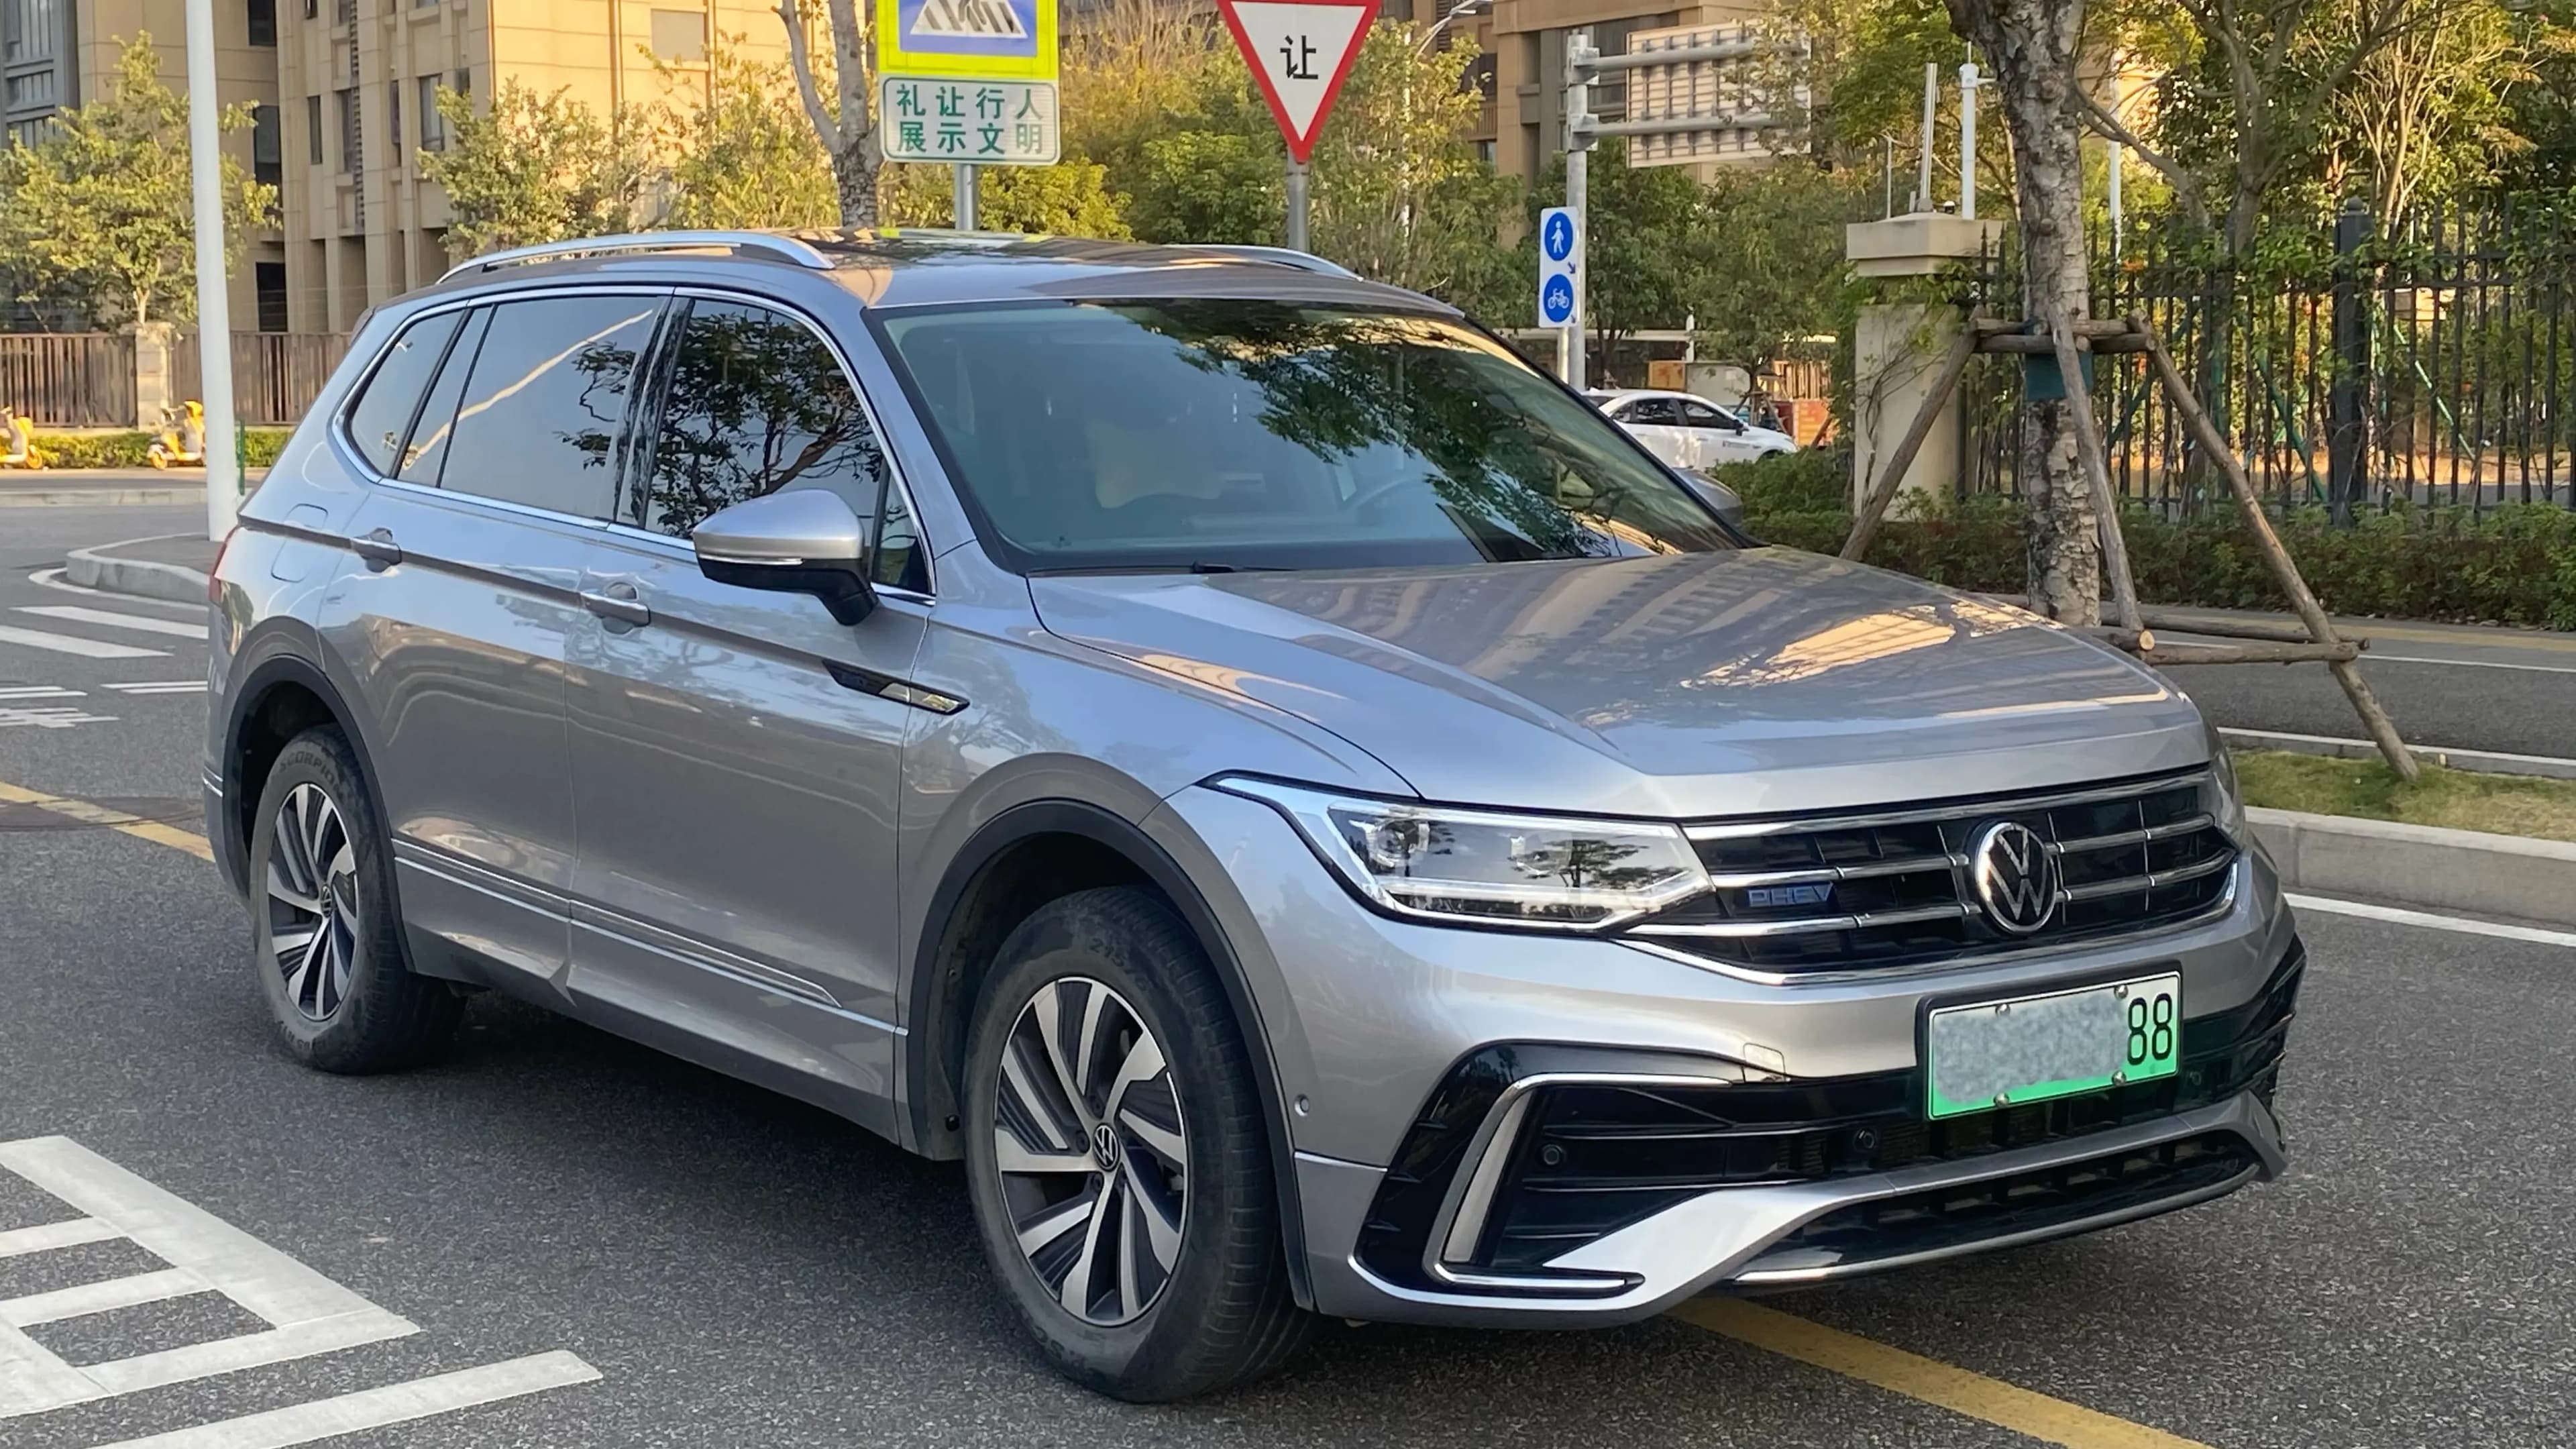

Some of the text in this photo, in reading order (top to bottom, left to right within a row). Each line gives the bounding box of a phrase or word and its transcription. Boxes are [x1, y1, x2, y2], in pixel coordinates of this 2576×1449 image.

[1279, 34, 1319, 80] 让
[896, 84, 1043, 120] 礼让行人
[897, 121, 1044, 155] 展示文明
[1748, 880, 1834, 908] PHEV
[2127, 993, 2173, 1066] 88
